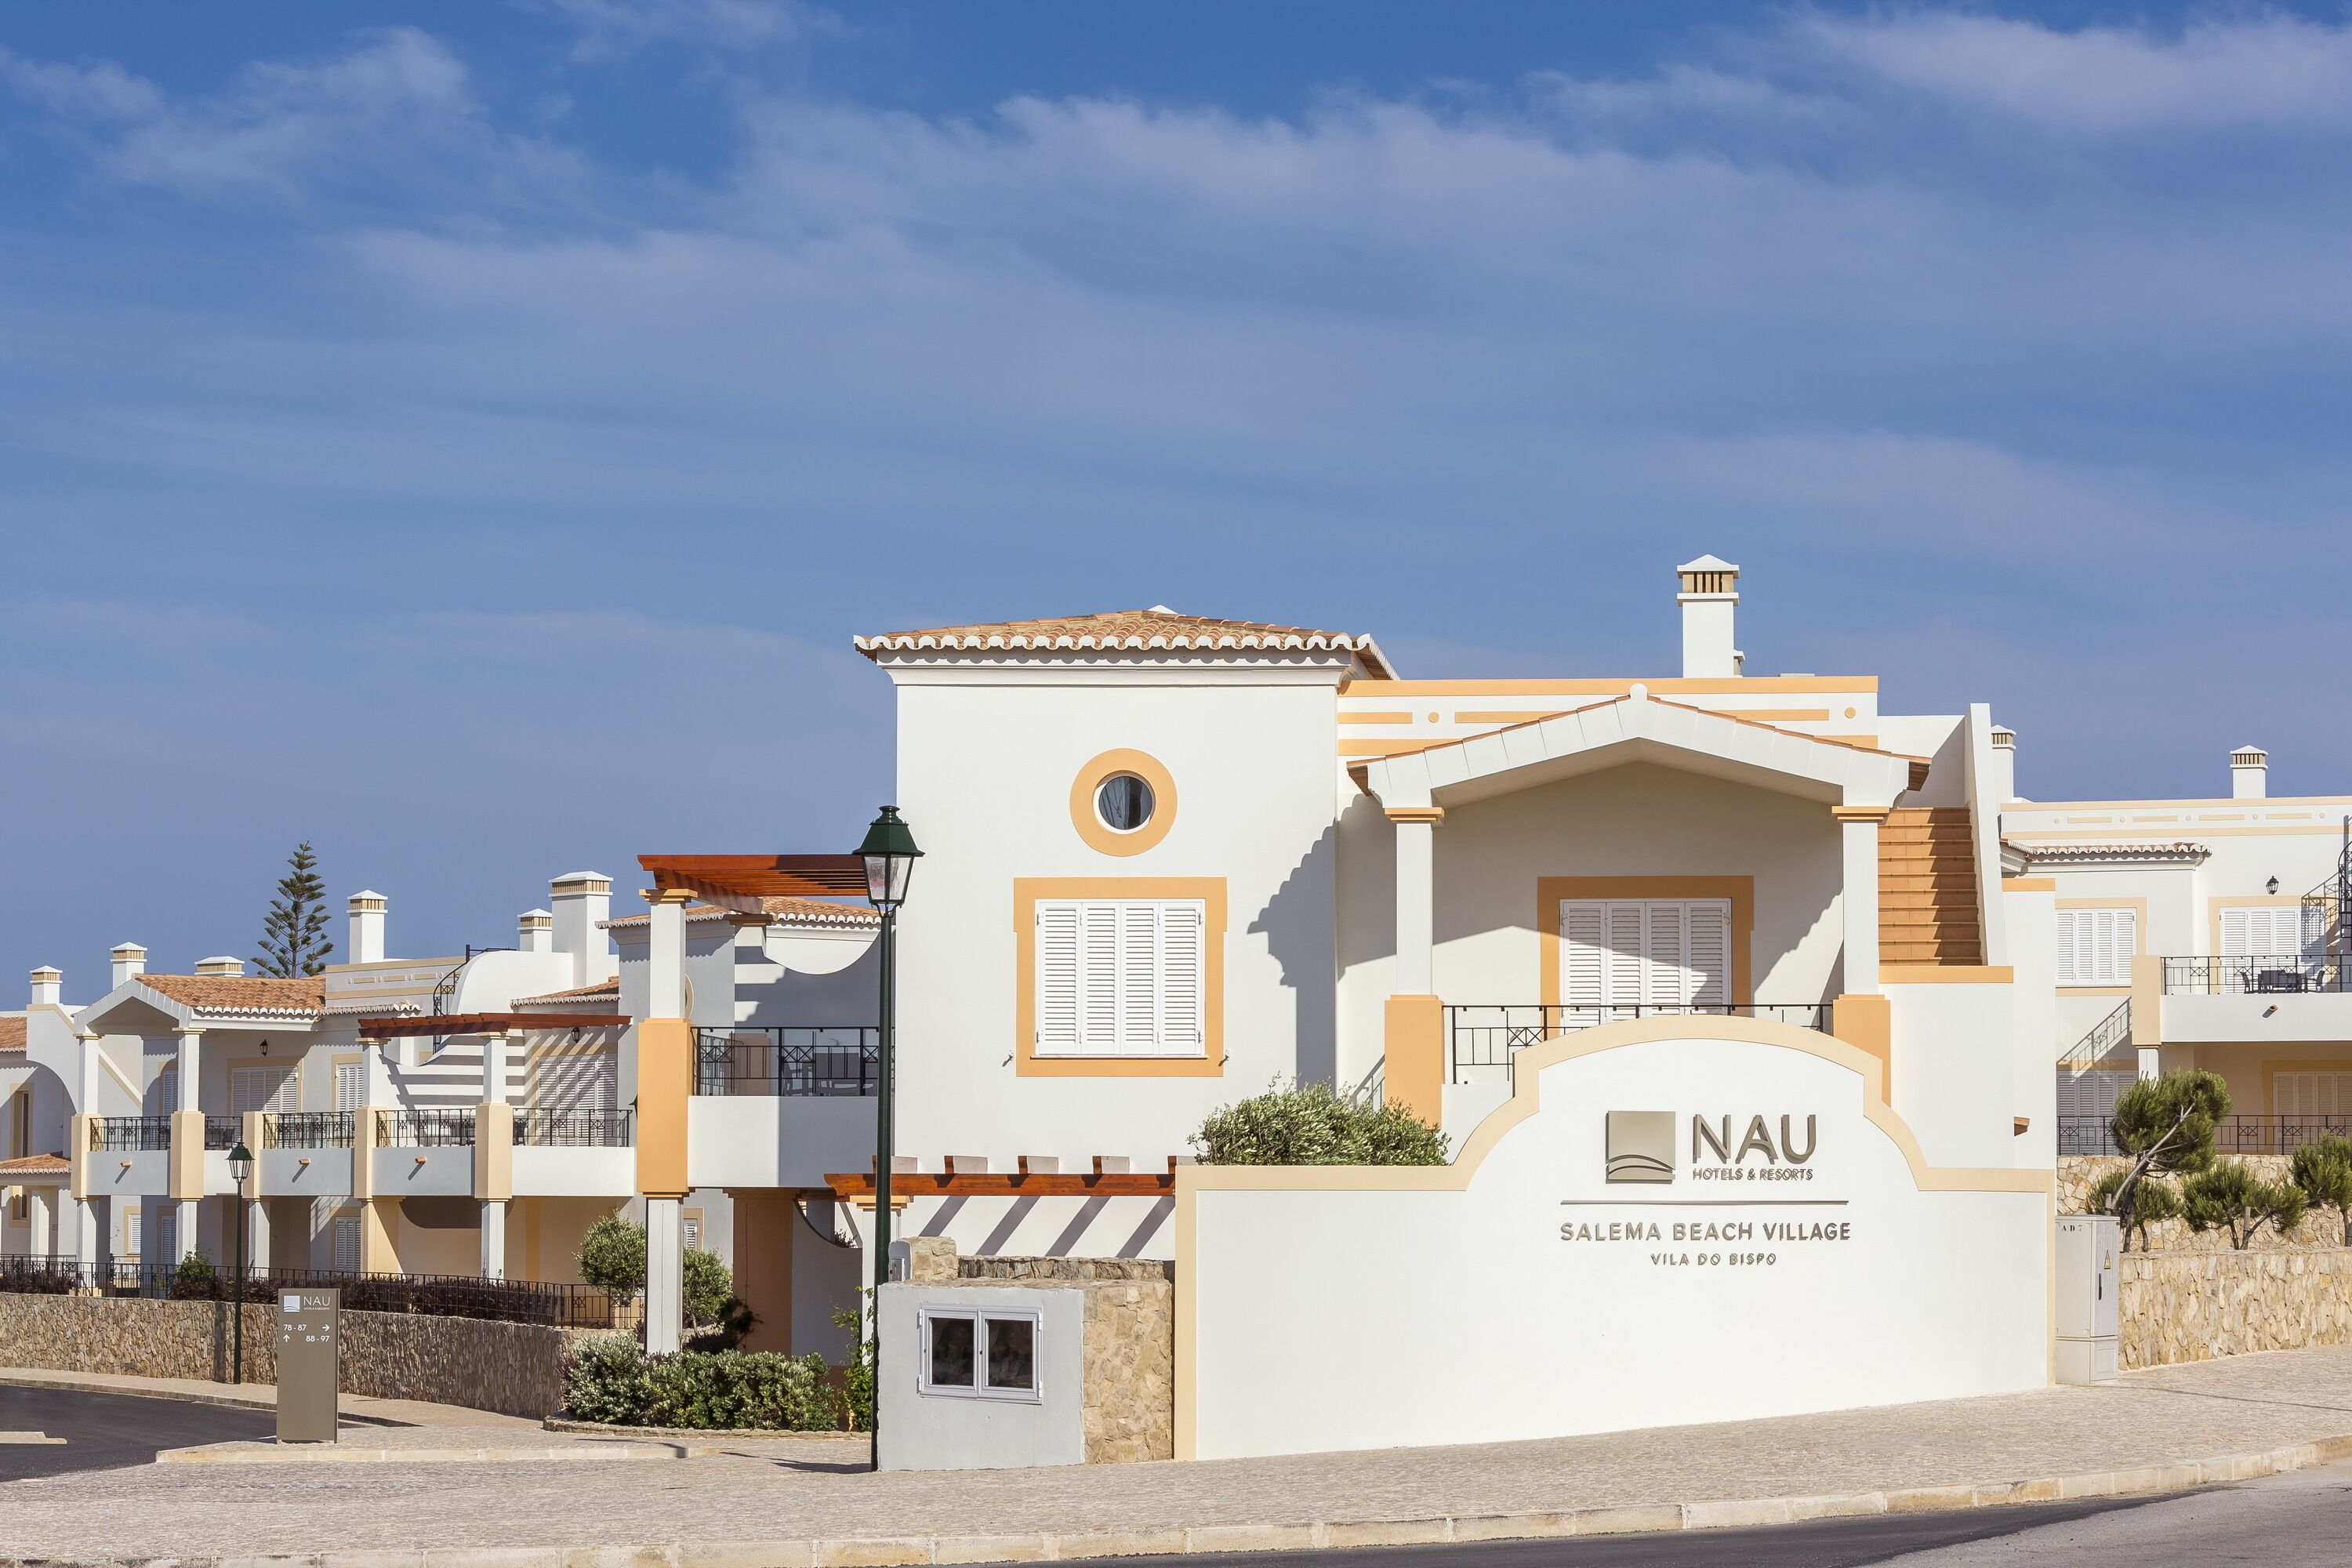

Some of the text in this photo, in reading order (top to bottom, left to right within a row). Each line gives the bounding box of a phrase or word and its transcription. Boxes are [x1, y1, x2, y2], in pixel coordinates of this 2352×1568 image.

[1693, 1114, 1817, 1164] NAU
[1693, 1168, 1813, 1181] HOTELS & RESORTS
[1560, 1222, 1850, 1241] SALEMA BEACH VILLAGE
[1650, 1253, 1777, 1265] VILA DO BISPO
[303, 1296, 330, 1306] NAU
